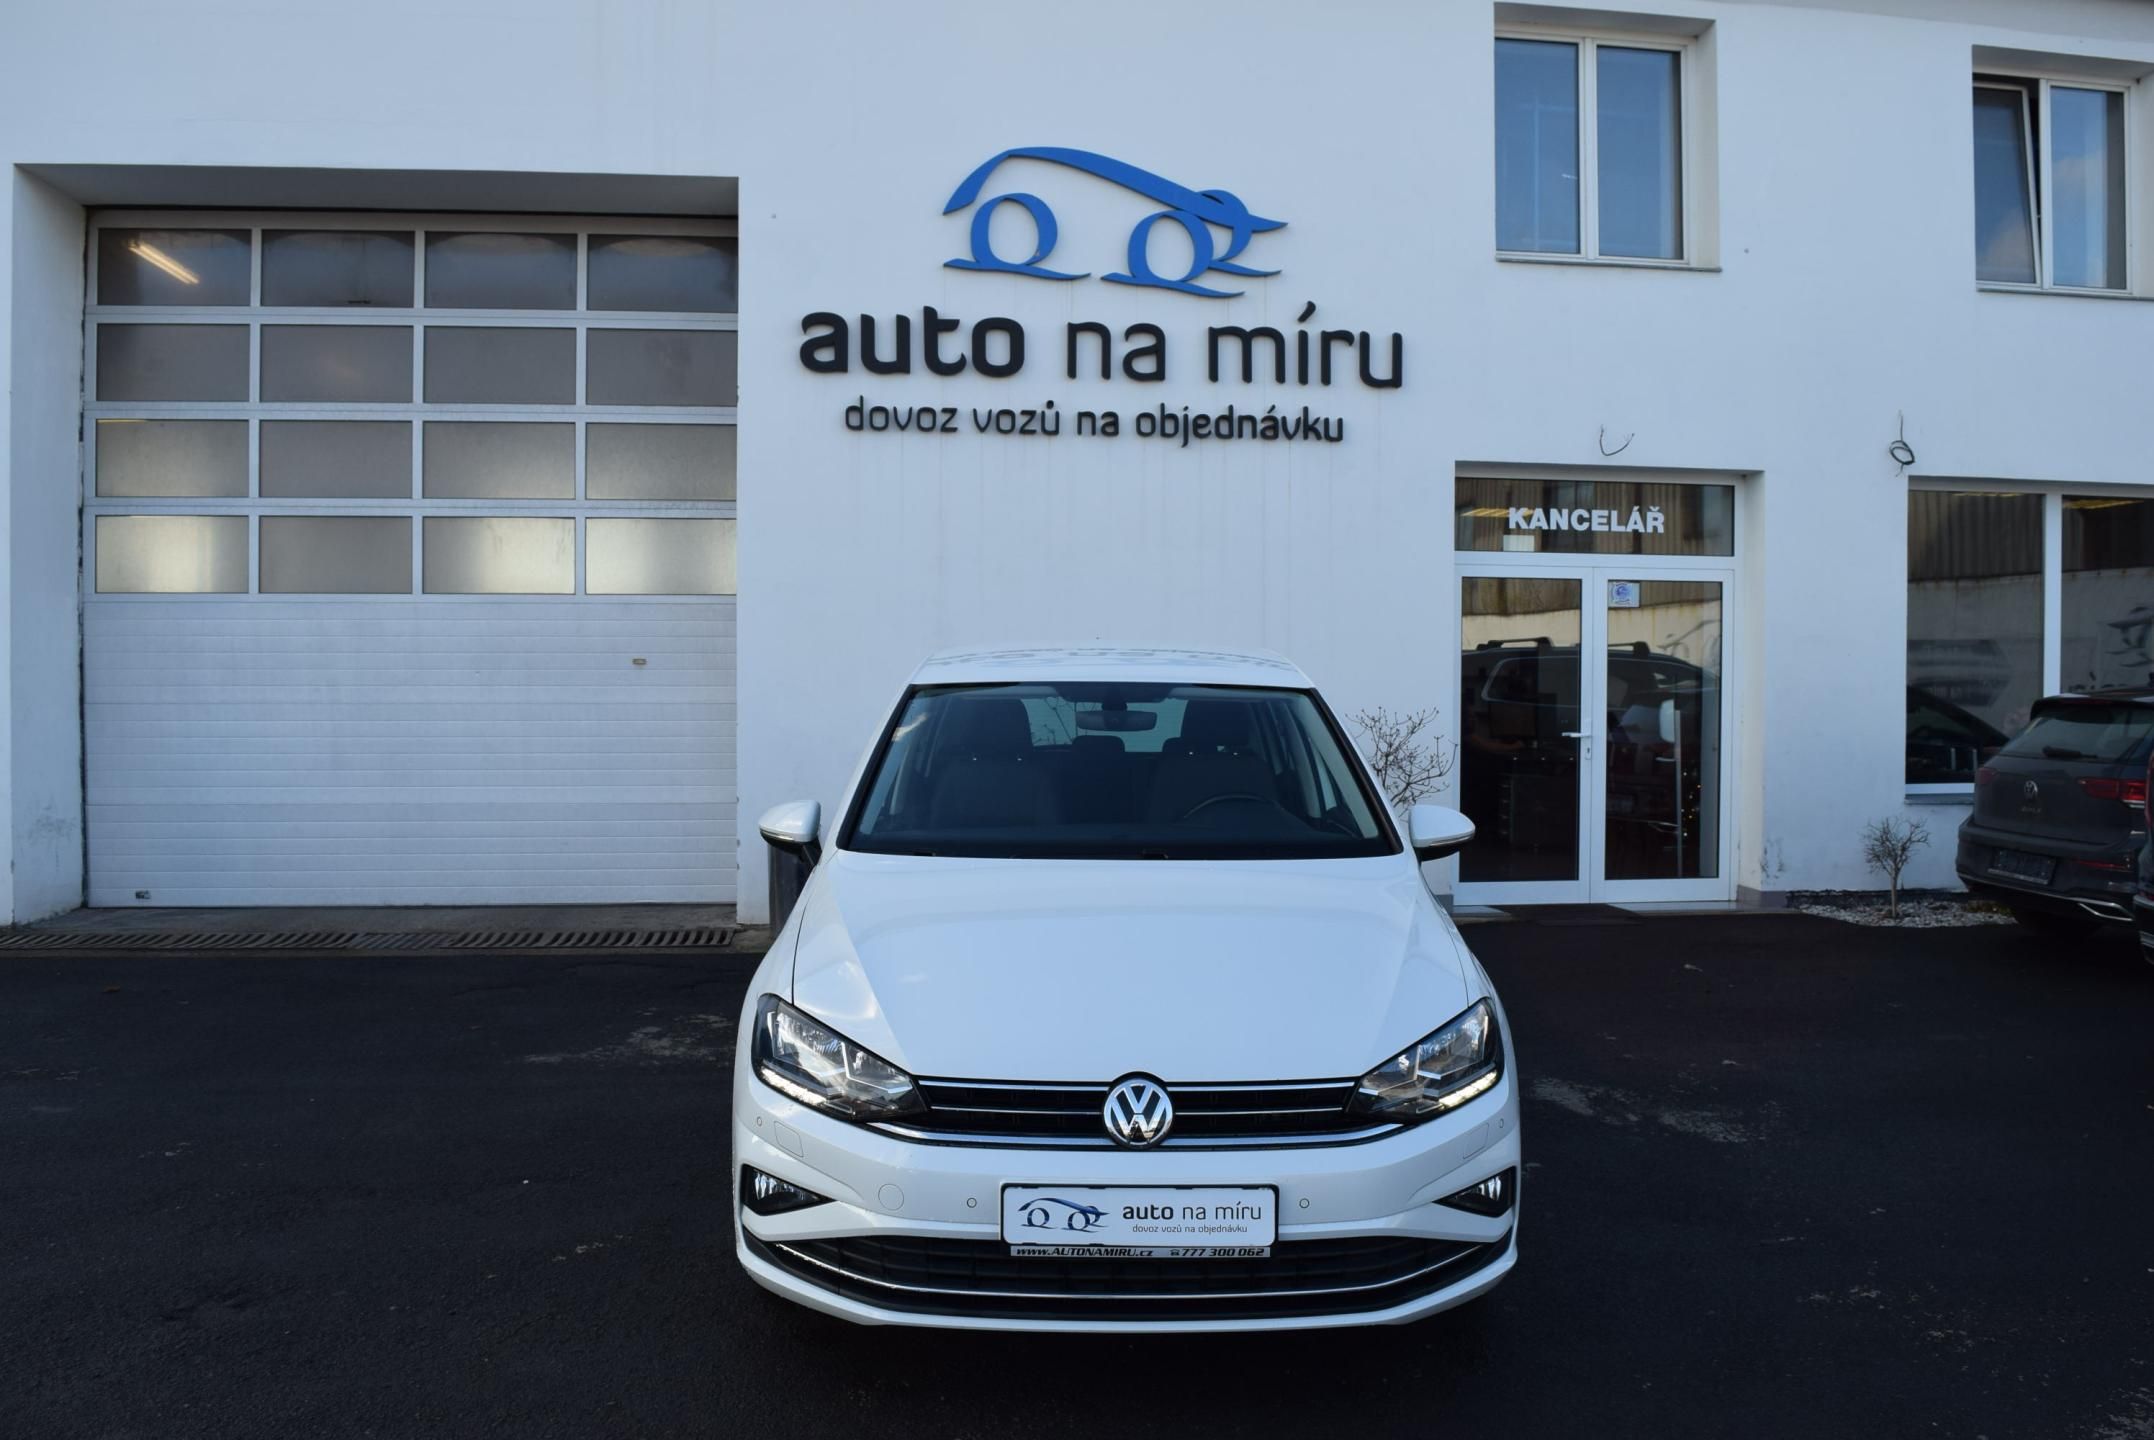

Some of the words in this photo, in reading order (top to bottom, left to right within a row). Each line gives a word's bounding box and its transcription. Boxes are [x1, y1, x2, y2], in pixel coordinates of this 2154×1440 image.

[799, 305, 1026, 379] auto
[1066, 321, 1167, 383] na
[1207, 300, 1404, 389] míru
[844, 394, 959, 434] dovoz
[972, 399, 1061, 437] vozů
[1076, 410, 1120, 437] na
[1135, 402, 1344, 448] objednávku
[1508, 505, 1665, 533] KANCELÁŘ
[1122, 1204, 1174, 1220] auto
[1182, 1206, 1207, 1220] na
[1215, 1200, 1262, 1220] míru
[1132, 1223, 1159, 1233] dovoz
[1198, 1224, 1248, 1235] objednávku
[1182, 1248, 1207, 1257] 777
[1209, 1248, 1236, 1257] 300
[1238, 1248, 1265, 1257] 062
